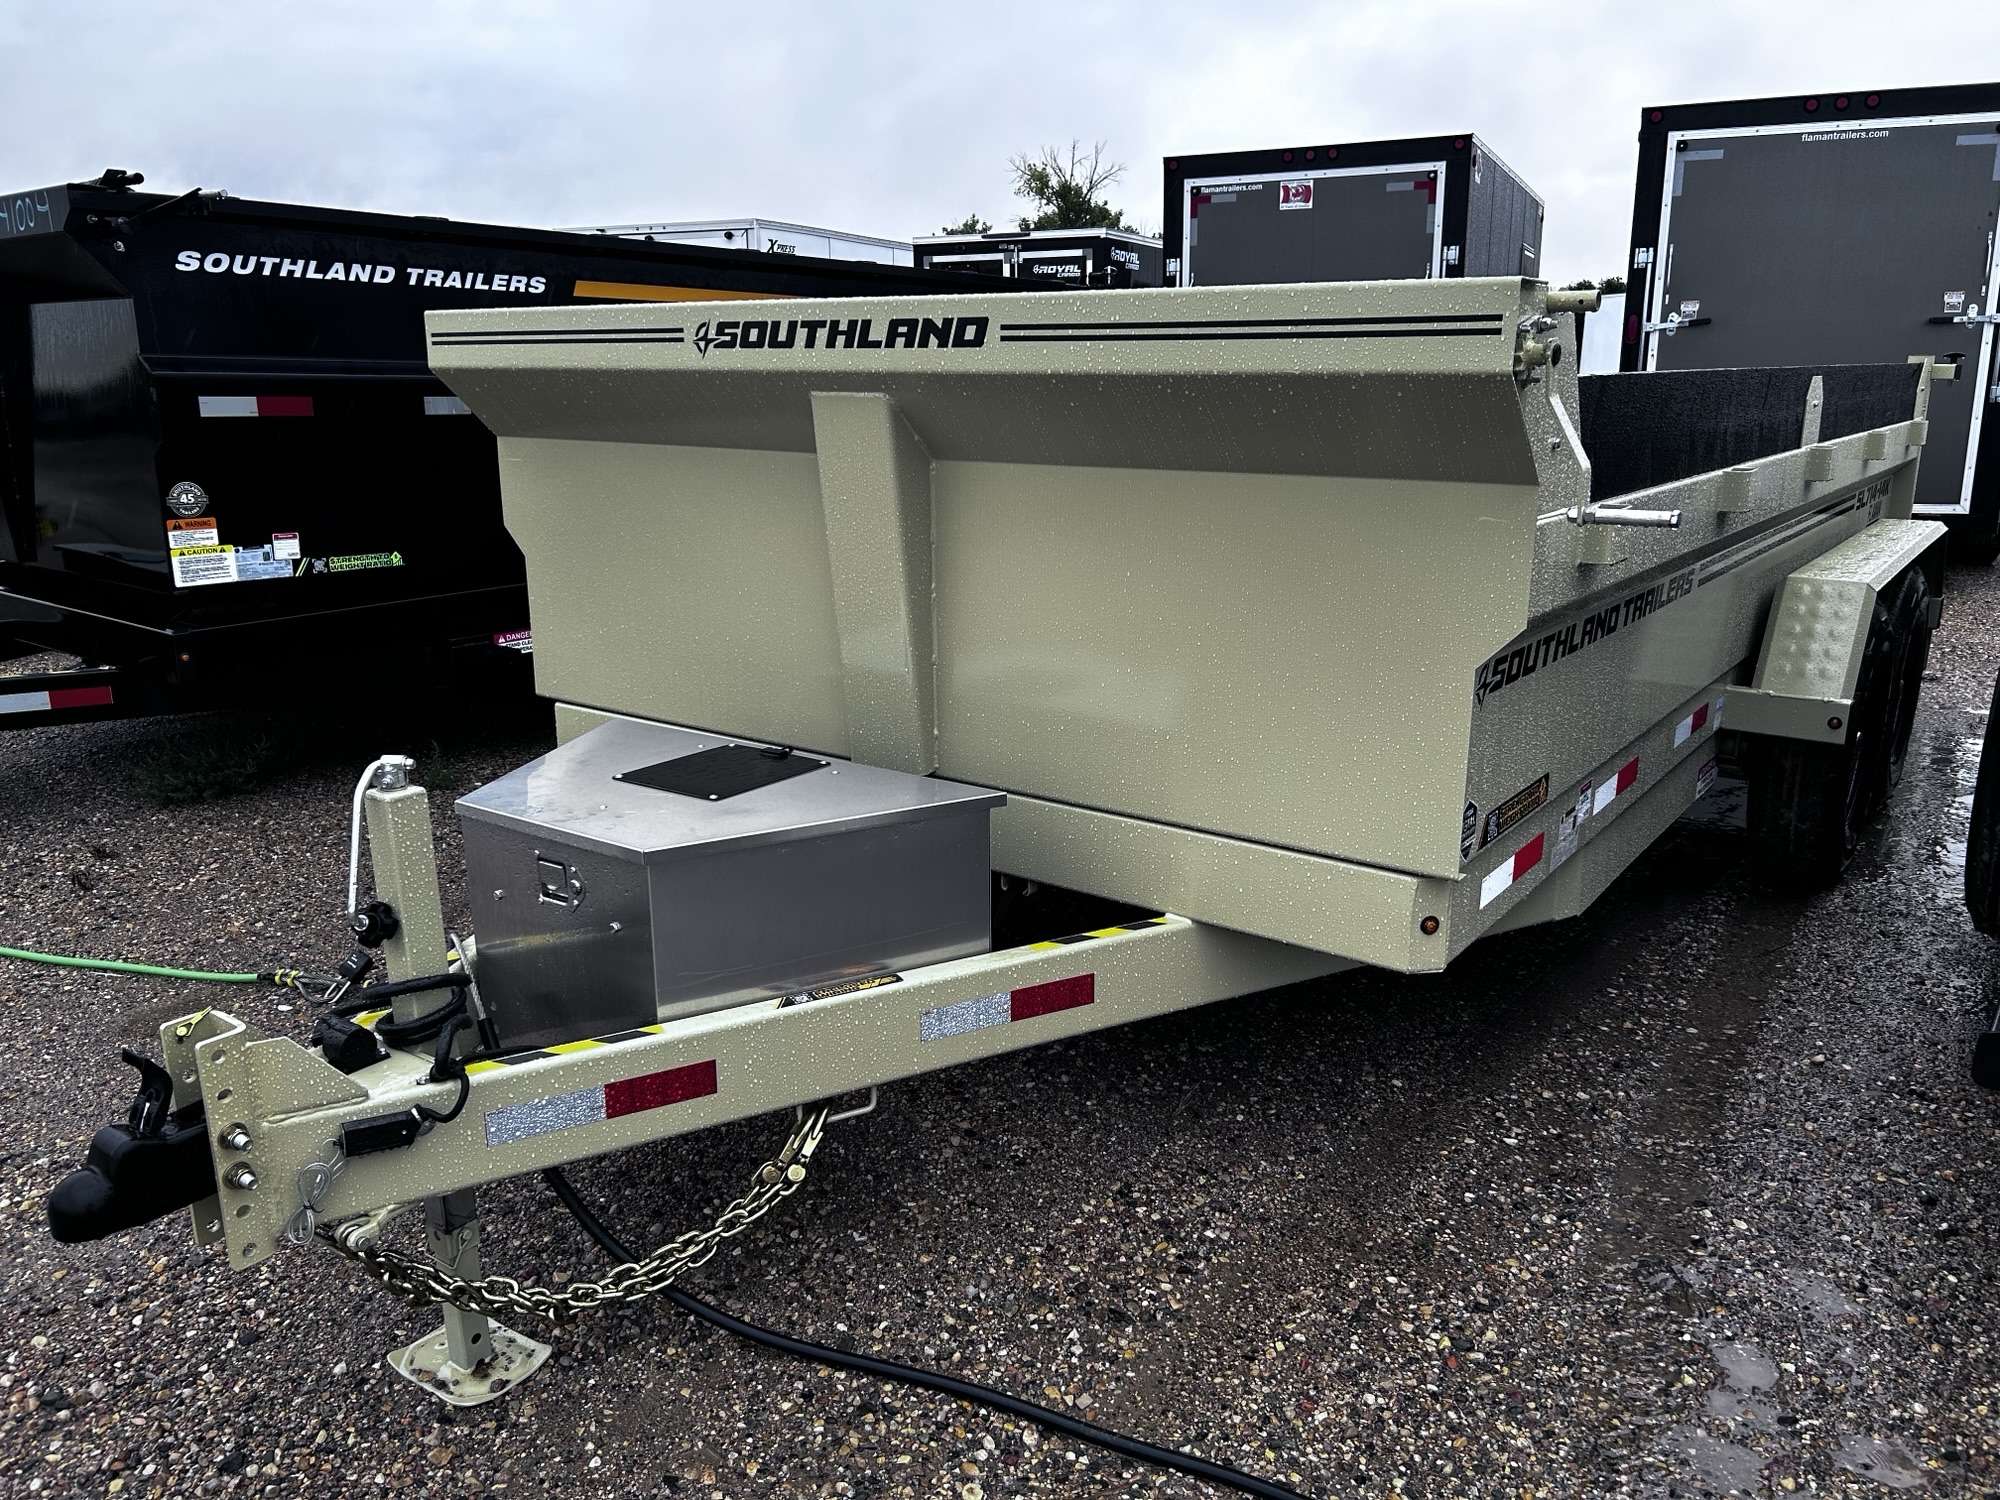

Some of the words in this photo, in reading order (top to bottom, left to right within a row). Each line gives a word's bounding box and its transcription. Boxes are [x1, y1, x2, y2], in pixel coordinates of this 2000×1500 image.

[1801, 129, 1889, 142] flamantrailers.com
[1200, 183, 1263, 194] flamantrailers.com
[175, 250, 396, 284] SOUTHLAND
[406, 267, 547, 294] TRAILERS
[1038, 264, 1081, 274] ROYAL
[713, 316, 990, 349] SOUTHLAND
[180, 494, 195, 504] 45
[187, 547, 218, 555] CAUTION
[1488, 603, 1622, 694] SOUTHLAND
[1622, 568, 1696, 627] TRAILERS
